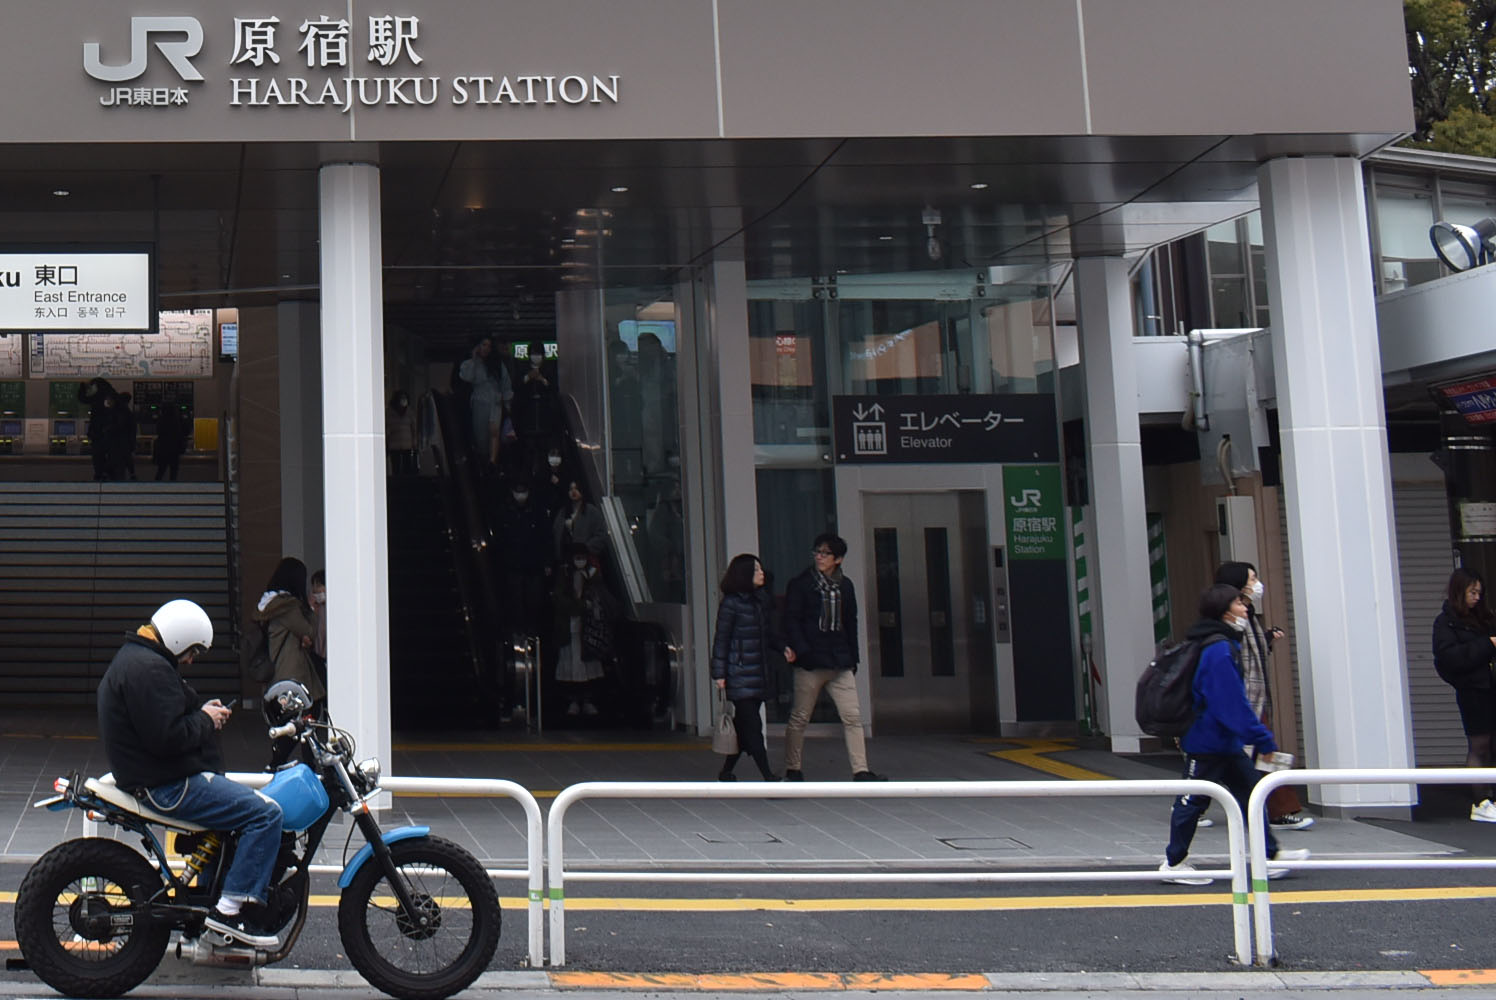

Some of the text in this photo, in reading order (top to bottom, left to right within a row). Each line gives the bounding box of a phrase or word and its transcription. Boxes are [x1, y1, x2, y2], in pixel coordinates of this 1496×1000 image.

[83, 16, 205, 82] JR
[229, 14, 424, 68] 原宿駅
[99, 86, 190, 107] JR東日本
[229, 75, 621, 112] HARAJUKU STATION
[34, 264, 79, 286] 東口
[34, 290, 128, 303] East Entrance
[34, 307, 68, 319] 东入口
[77, 307, 127, 319] 동쪽 입구
[514, 343, 559, 358] 原駅
[899, 410, 1025, 432] エレベーター
[900, 435, 953, 449] Elevator
[1010, 489, 1042, 507] JR
[1013, 516, 1057, 533] 原宿駅
[1014, 534, 1054, 545] Harajuku
[1014, 544, 1046, 554] Station
